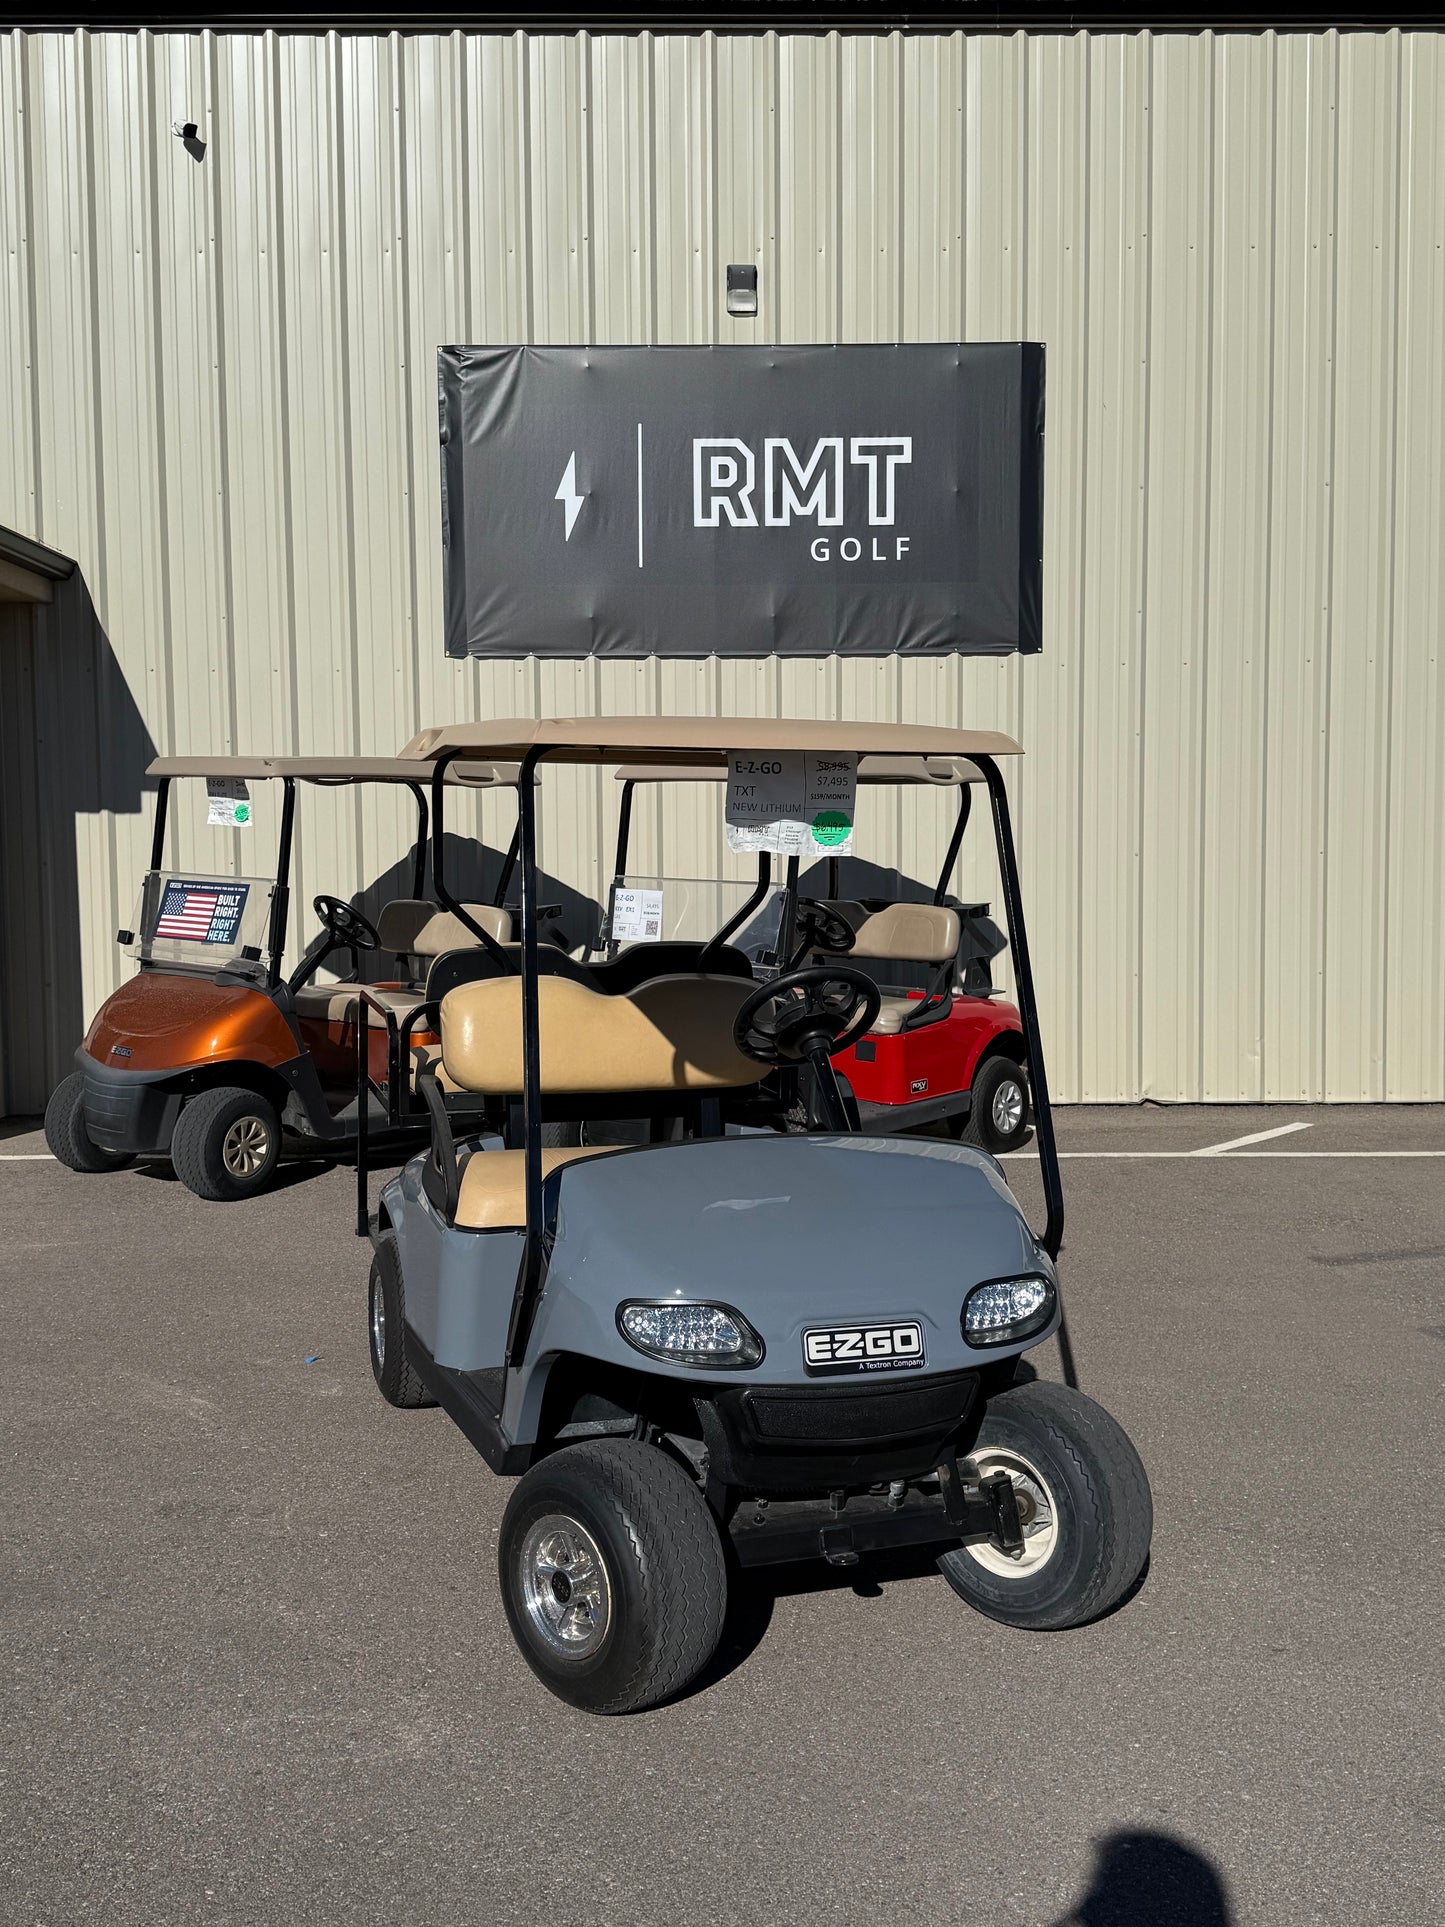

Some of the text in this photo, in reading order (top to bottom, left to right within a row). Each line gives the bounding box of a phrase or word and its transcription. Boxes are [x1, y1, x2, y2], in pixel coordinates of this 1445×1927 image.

[693, 436, 913, 527] RMT
[810, 536, 910, 562] GOLF
[735, 760, 782, 775] E-Z-GO
[817, 775, 848, 787] $7,495
[734, 785, 757, 797] TXT
[732, 802, 801, 813] NEW LITHIUM
[217, 894, 241, 906] BUILT
[214, 906, 239, 918] RIGHT.
[210, 918, 236, 931] RIGHT
[207, 930, 230, 942] HERE.
[807, 1328, 920, 1360] EZGO
[858, 1359, 925, 1370] A Textron Company
